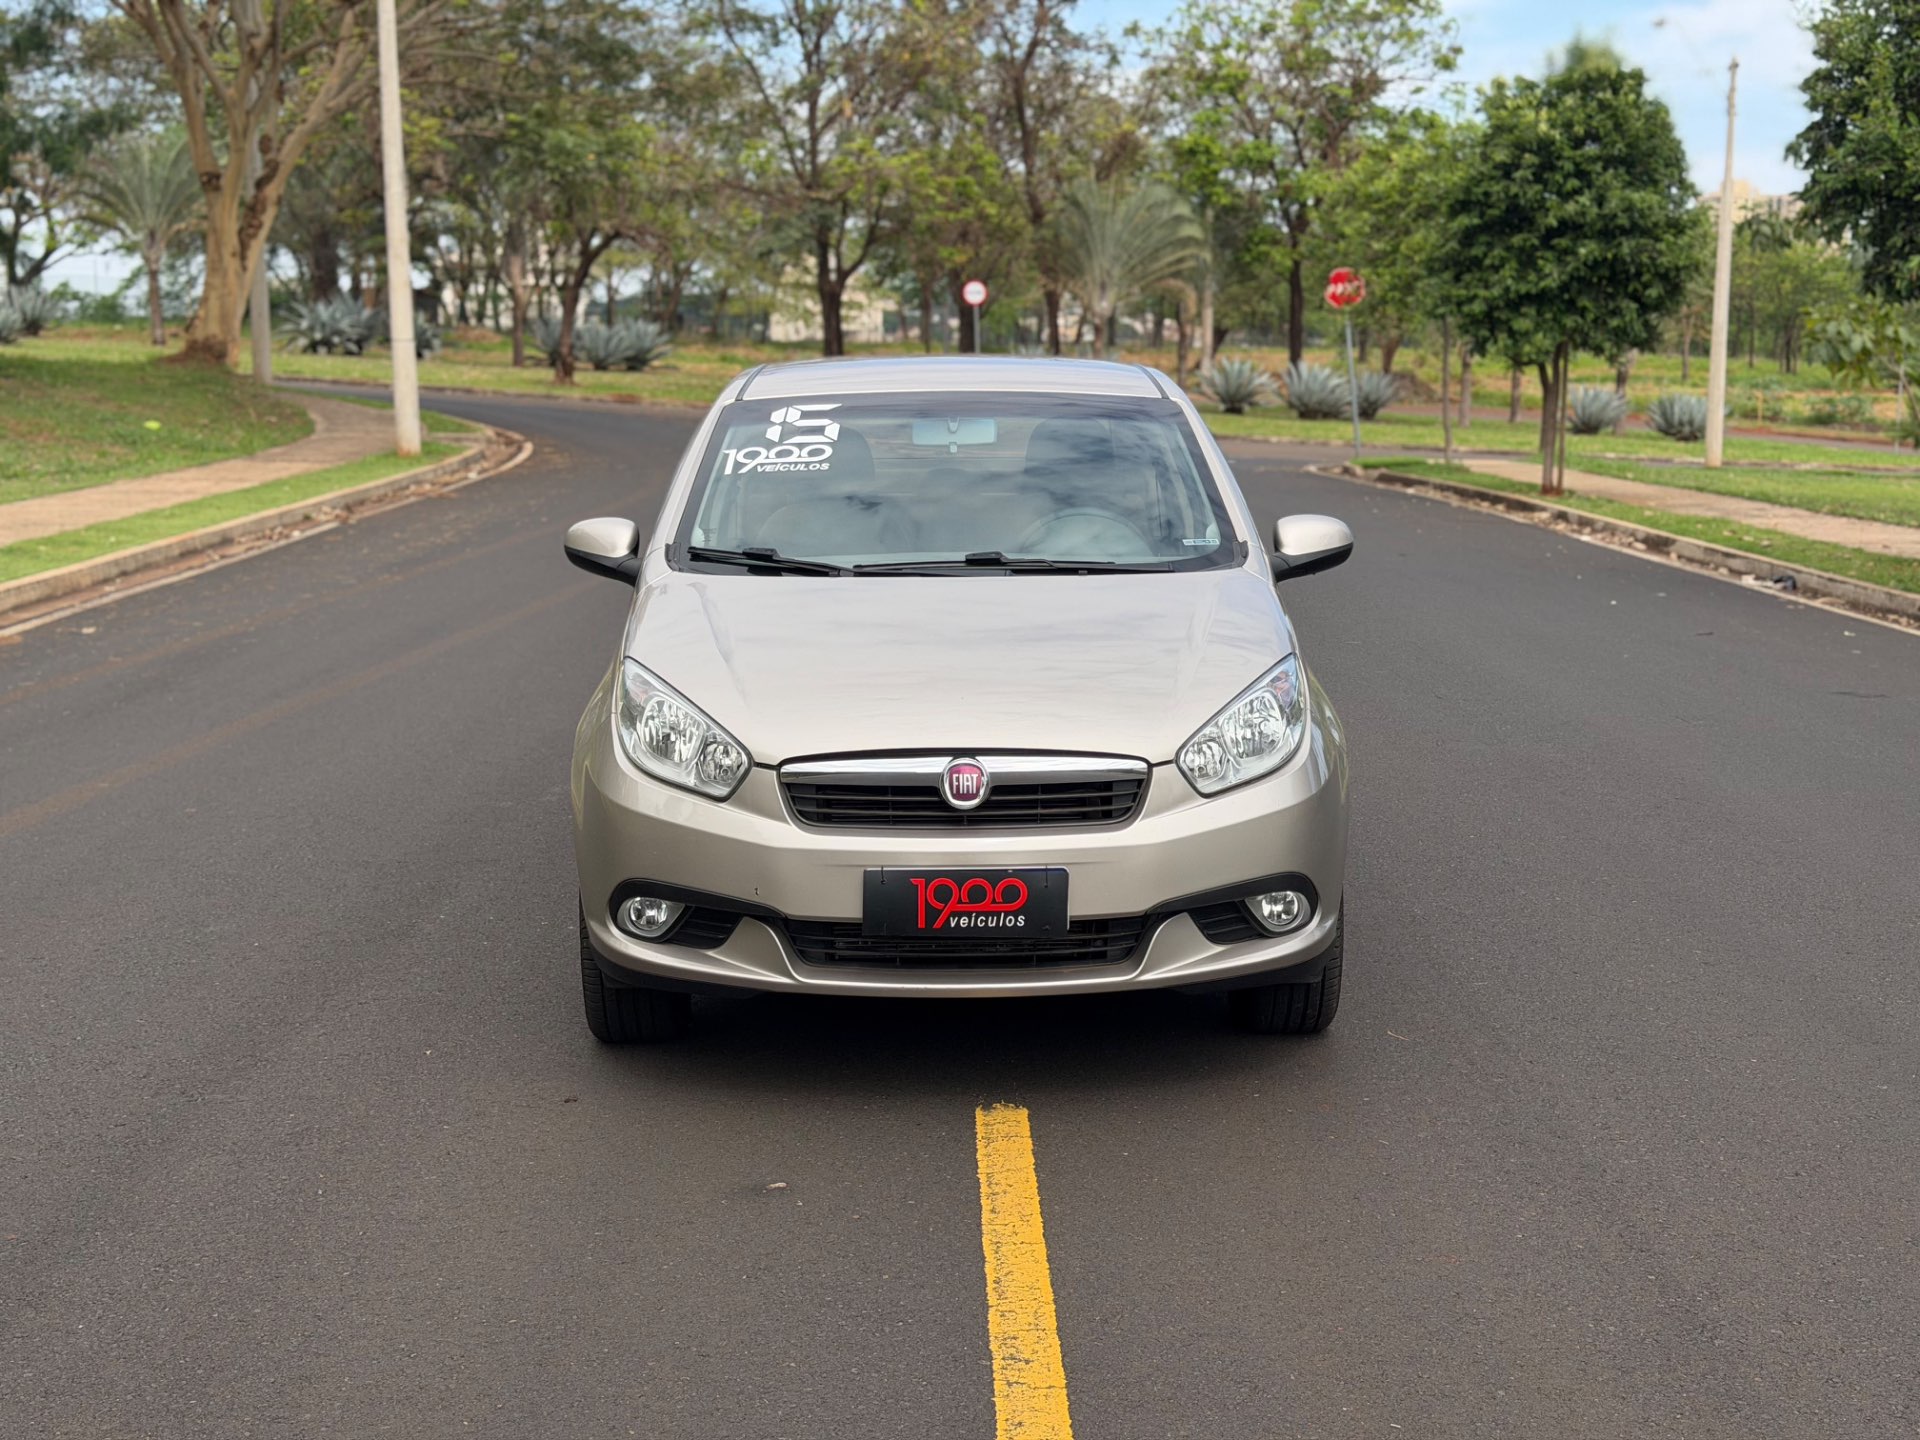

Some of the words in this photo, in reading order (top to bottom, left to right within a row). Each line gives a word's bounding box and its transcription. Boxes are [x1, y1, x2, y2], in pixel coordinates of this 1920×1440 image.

[765, 403, 842, 443] 15
[723, 444, 833, 475] 1900
[756, 462, 831, 473] VEÍCULOS
[952, 773, 979, 795] FIAT
[909, 877, 1029, 929] 1900
[949, 911, 1026, 928] veículos
